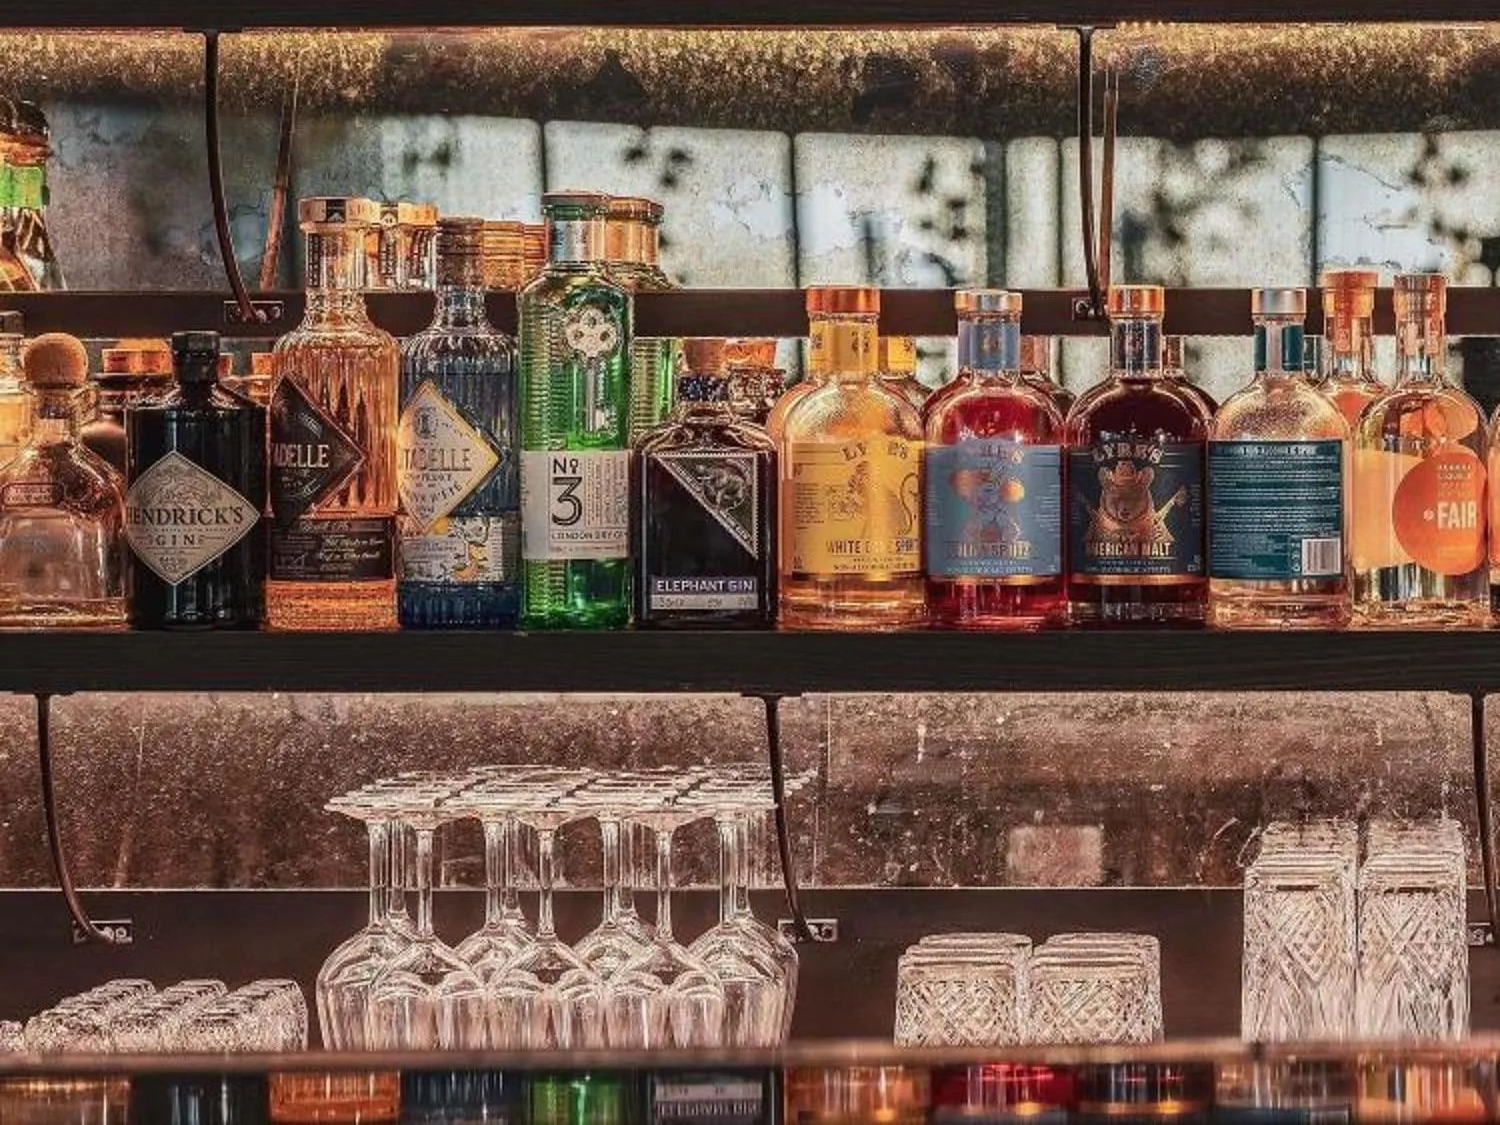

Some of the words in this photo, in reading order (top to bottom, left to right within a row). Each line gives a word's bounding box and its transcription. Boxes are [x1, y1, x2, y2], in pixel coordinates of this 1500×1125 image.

[551, 476, 583, 526] 3
[125, 504, 244, 526] HENDRICK'S
[1436, 501, 1477, 530] FAIR
[156, 534, 198, 546] GIN
[826, 540, 861, 555] WHITE
[657, 579, 725, 592] ELEPHANT
[727, 579, 754, 592] GIN
